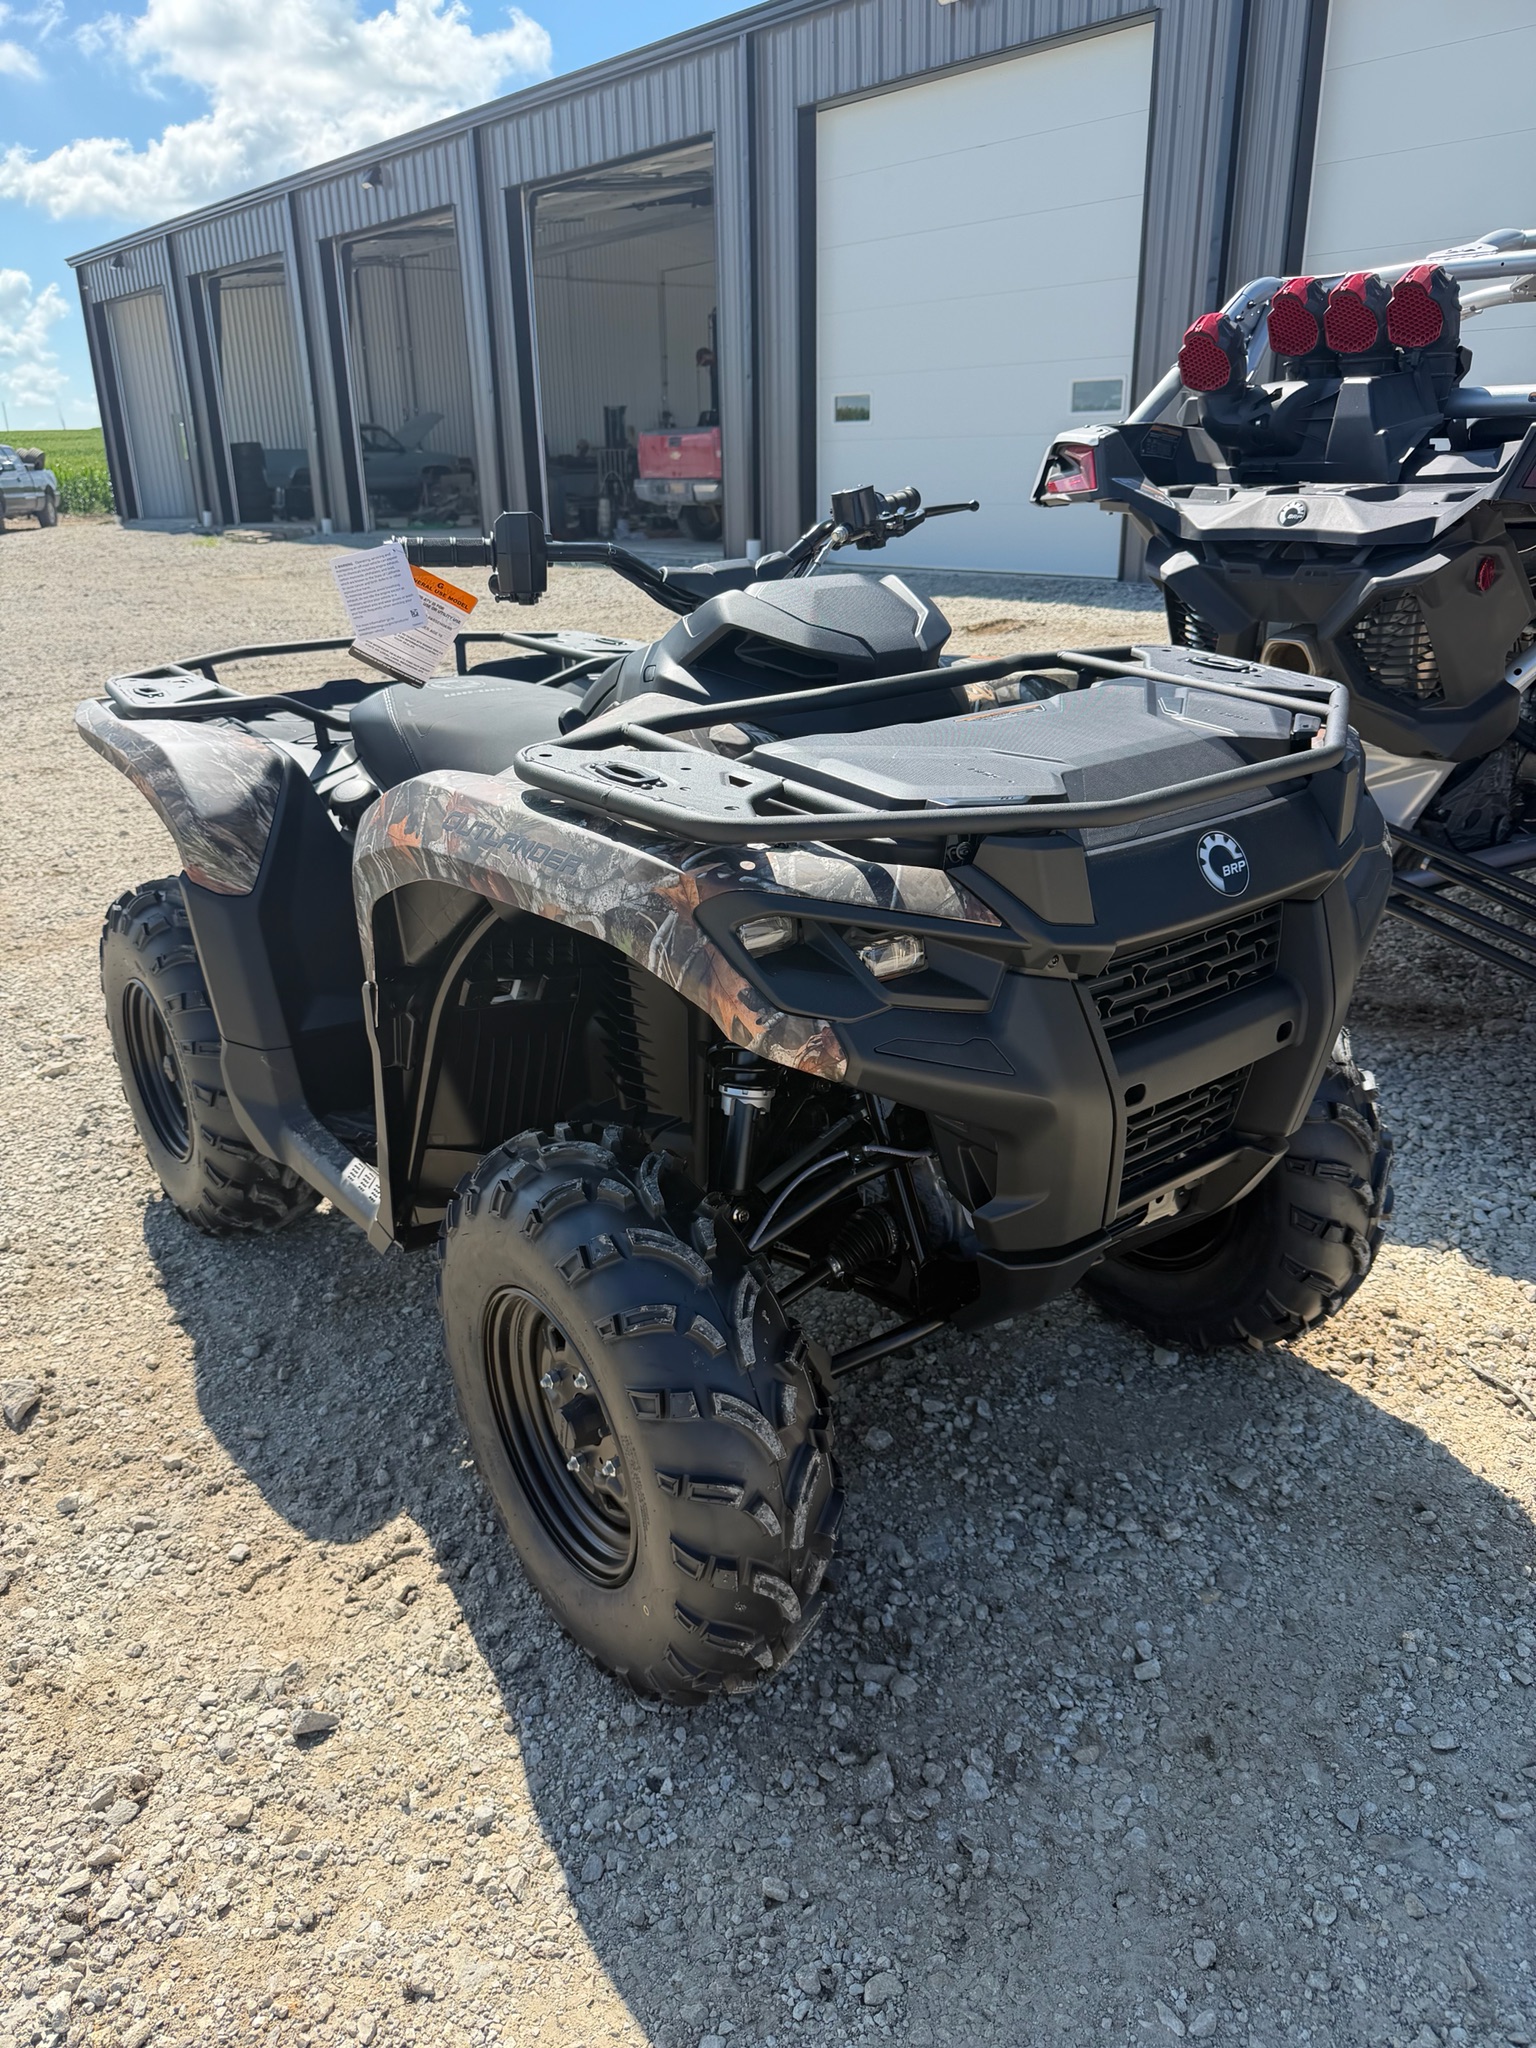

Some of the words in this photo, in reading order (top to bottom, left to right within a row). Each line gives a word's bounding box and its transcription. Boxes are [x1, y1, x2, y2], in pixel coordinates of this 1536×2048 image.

[413, 578, 433, 591] NERAL
[434, 589, 447, 597] USE
[448, 596, 468, 609] MODEL
[442, 811, 583, 876] OUTLANDER
[1222, 860, 1246, 877] BRP
